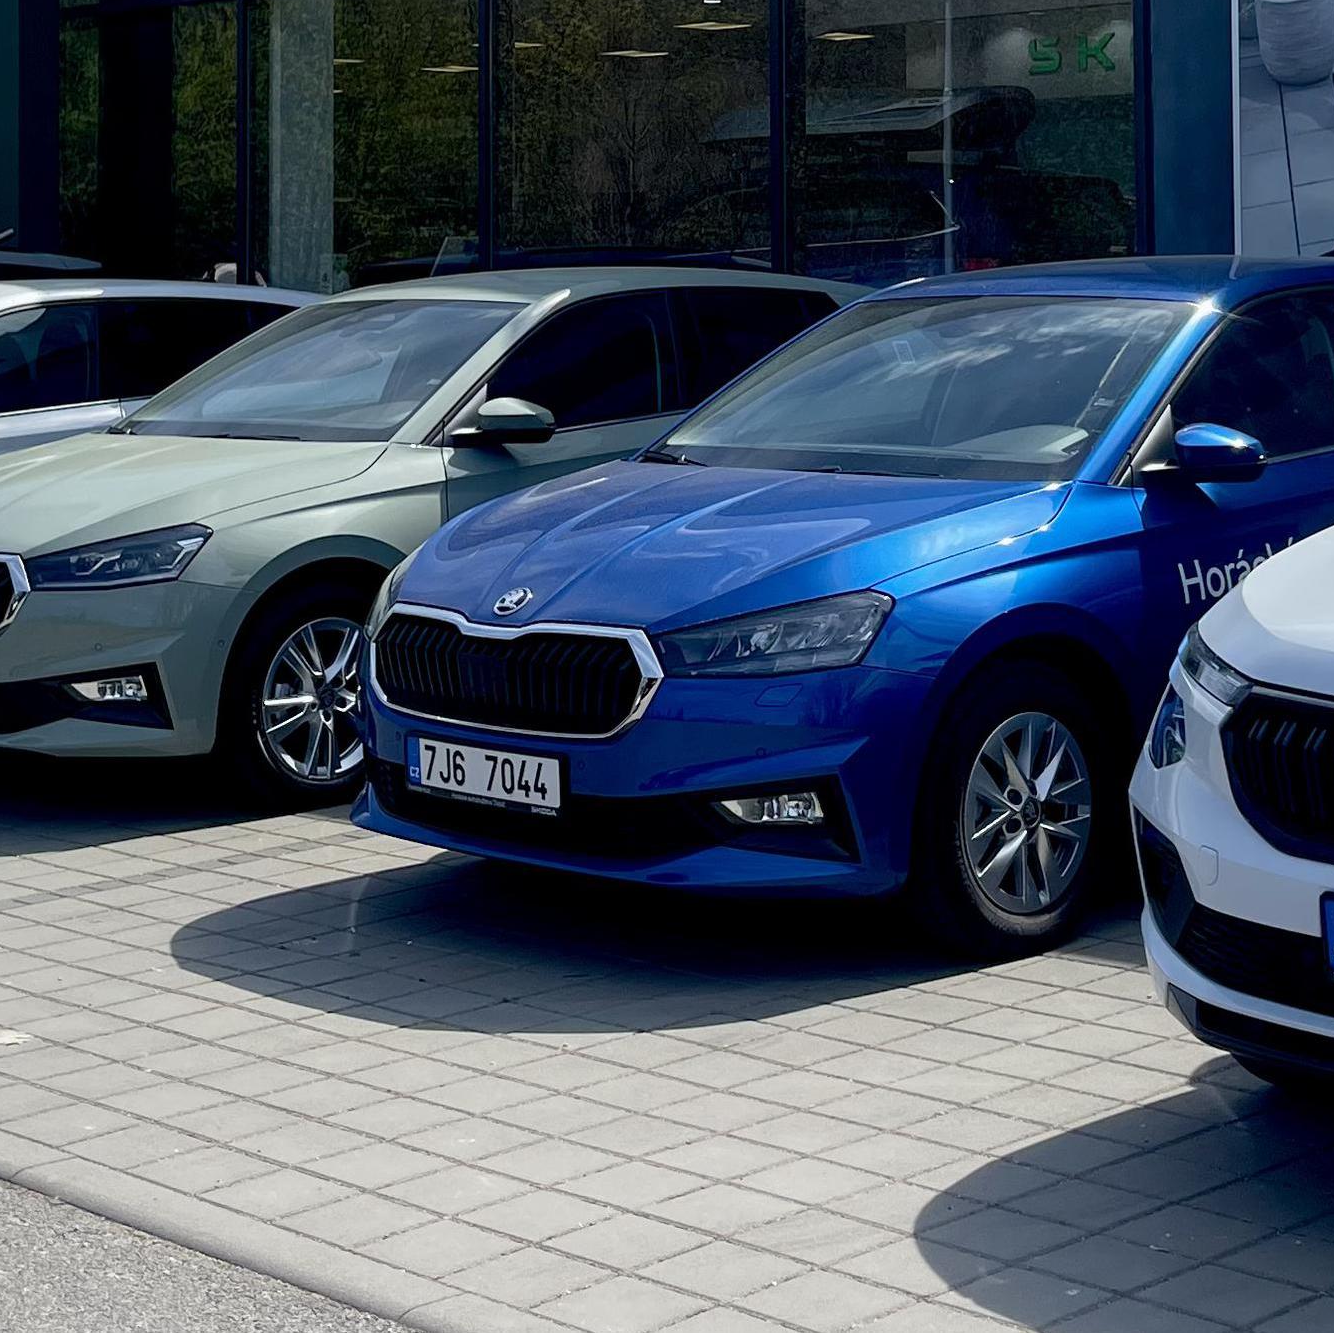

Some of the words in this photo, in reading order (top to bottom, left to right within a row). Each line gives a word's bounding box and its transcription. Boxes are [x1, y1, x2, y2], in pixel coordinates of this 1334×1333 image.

[409, 765, 420, 778] CZ
[424, 744, 466, 786] 7J6
[485, 754, 547, 800] 7044
